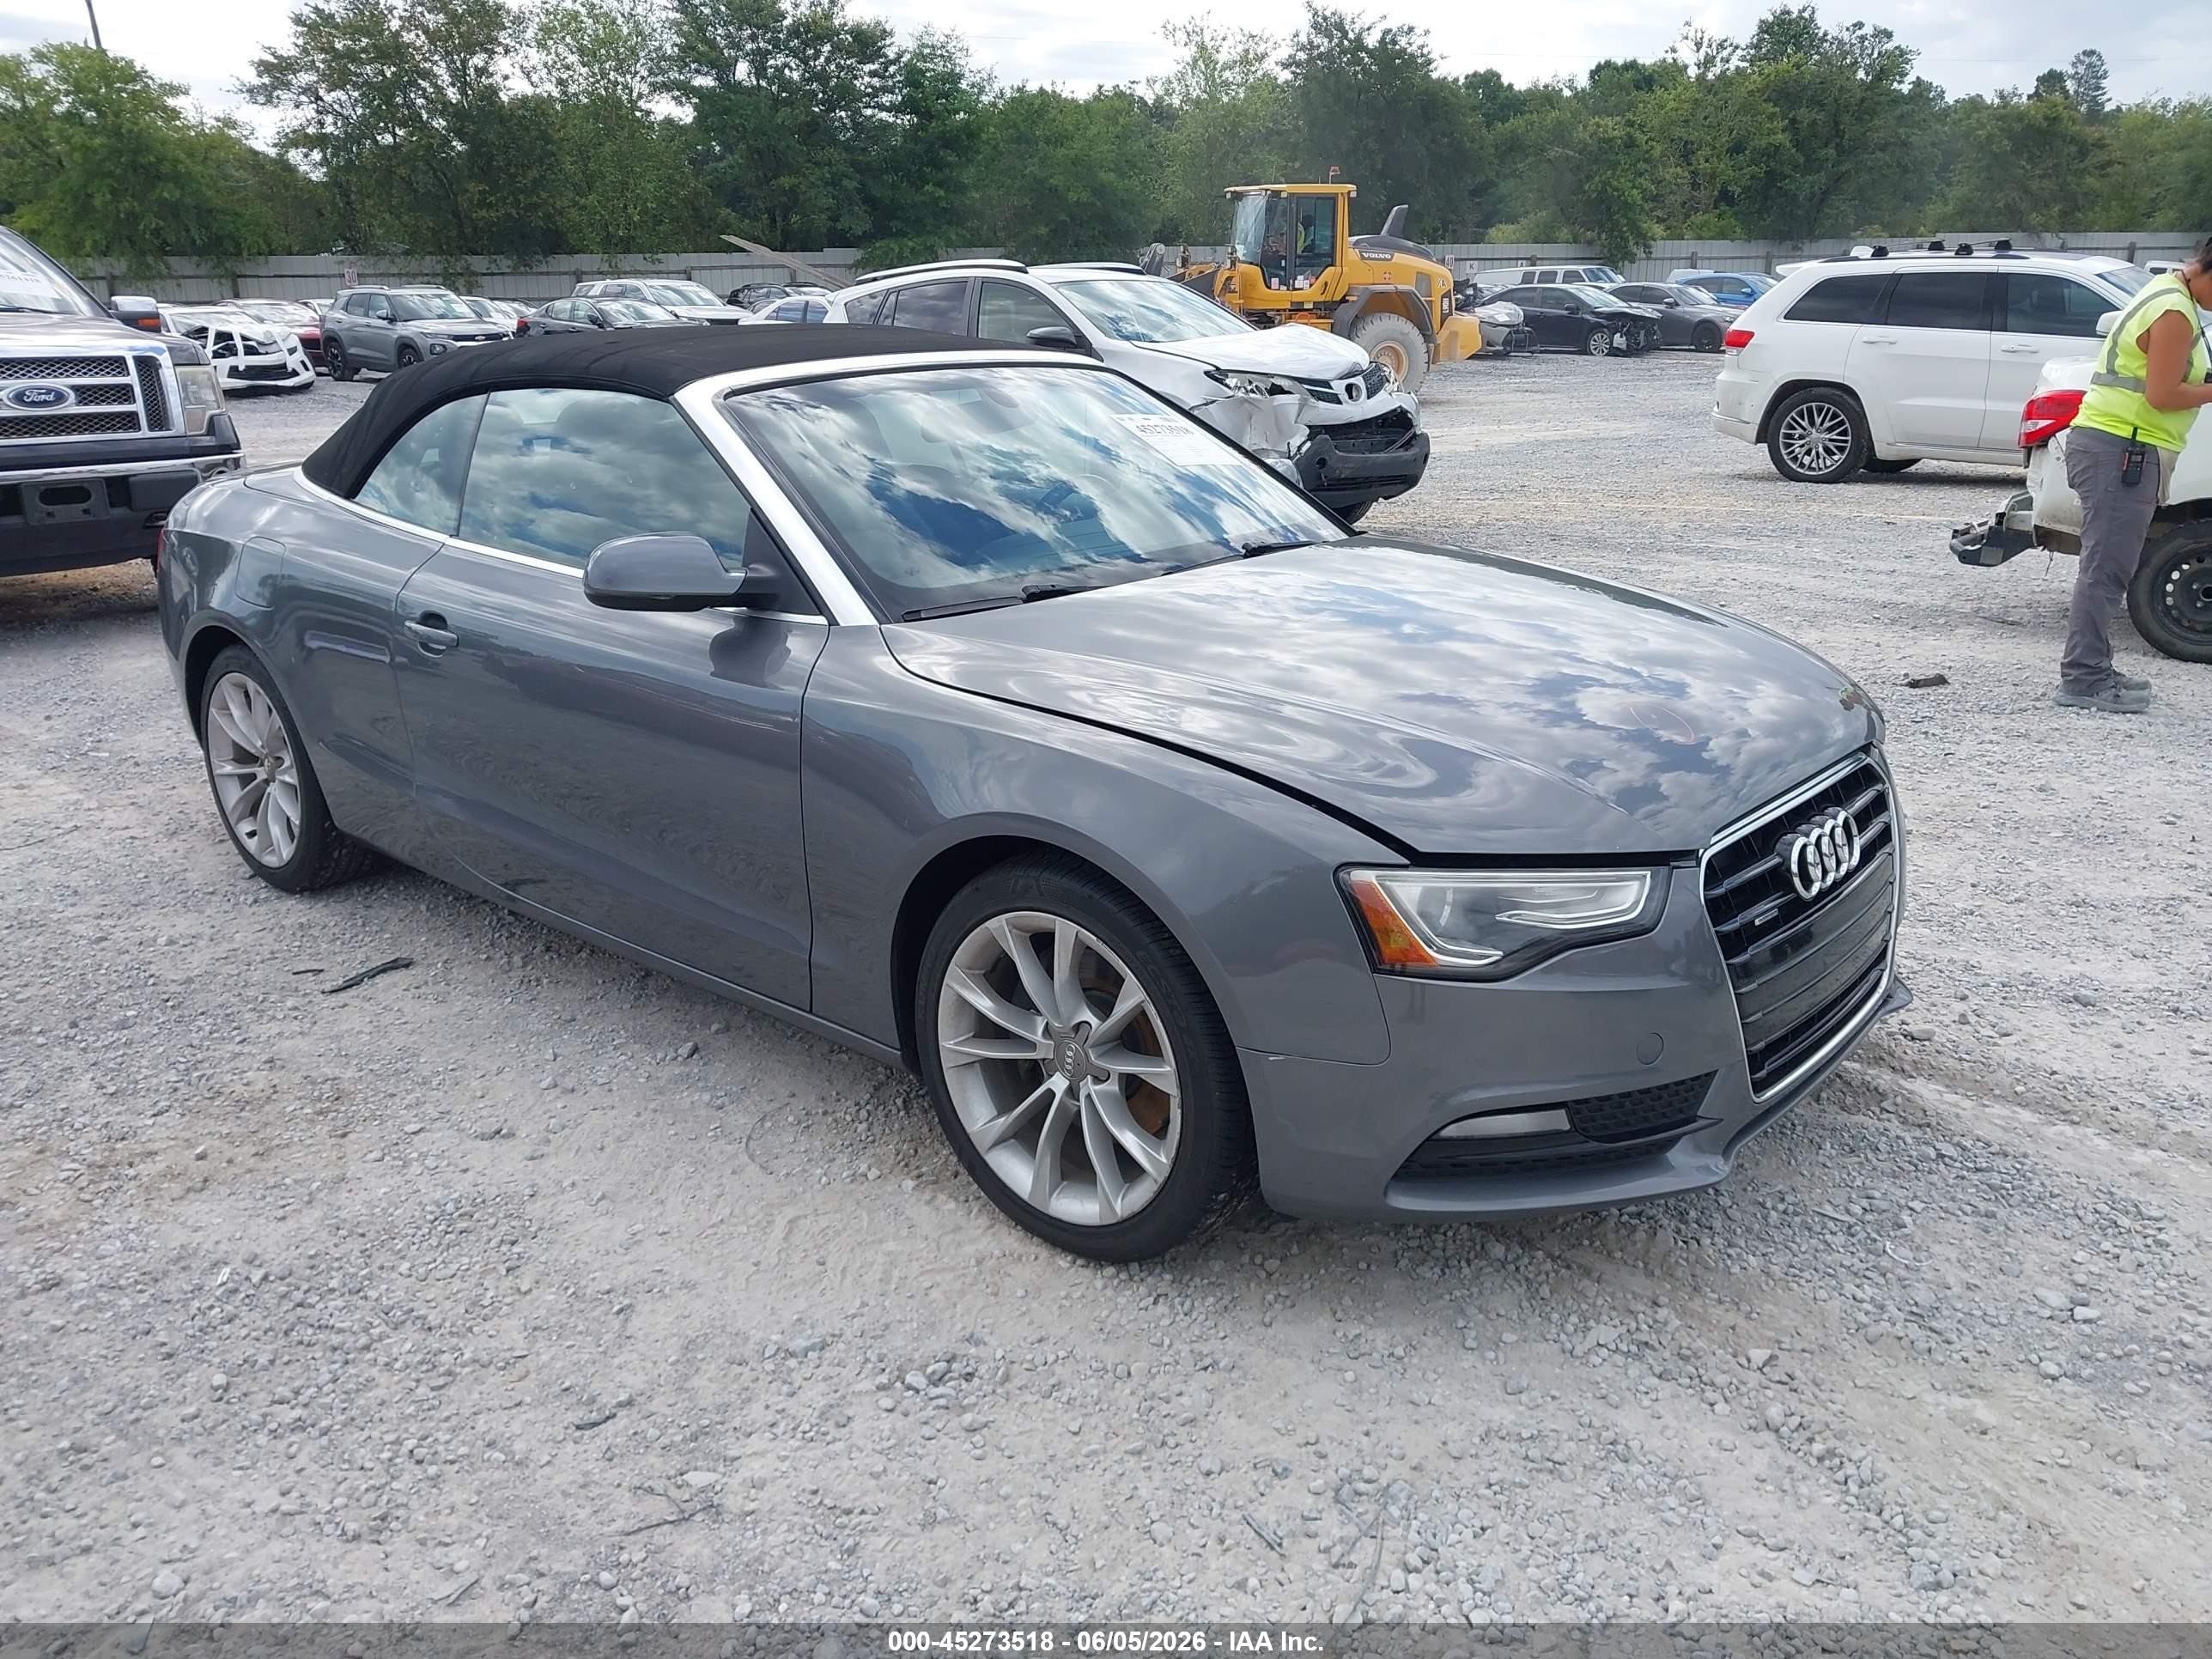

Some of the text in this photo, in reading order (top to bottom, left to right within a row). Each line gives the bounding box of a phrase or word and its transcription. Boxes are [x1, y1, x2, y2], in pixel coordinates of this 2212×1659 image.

[1445, 256, 1454, 269] 40
[345, 270, 356, 283] 30
[23, 389, 57, 403] Ford
